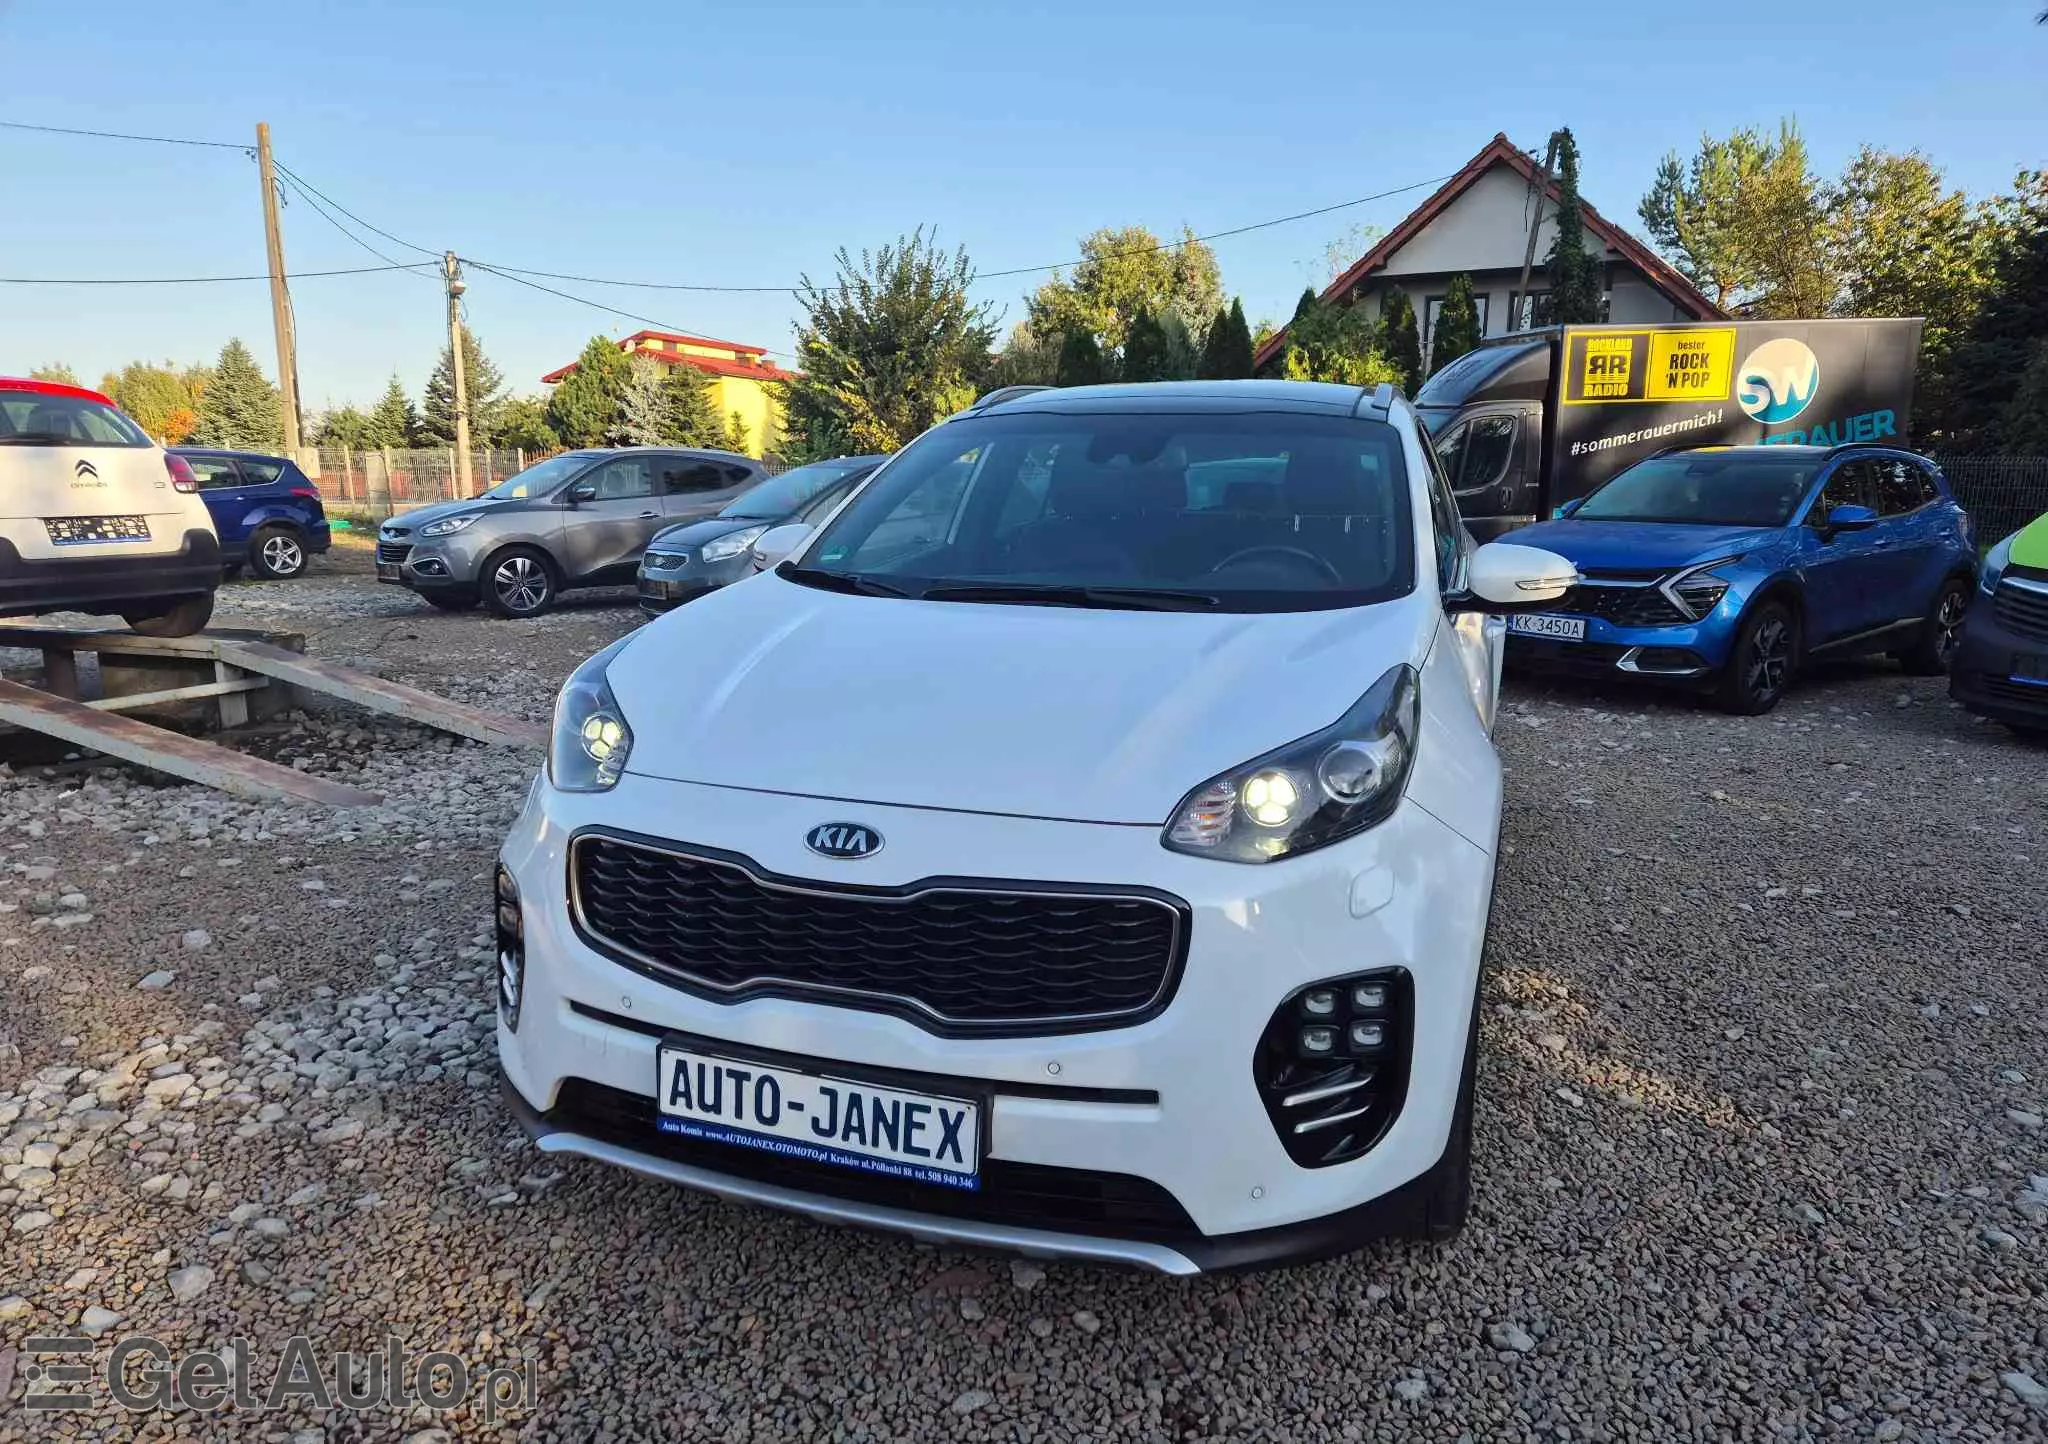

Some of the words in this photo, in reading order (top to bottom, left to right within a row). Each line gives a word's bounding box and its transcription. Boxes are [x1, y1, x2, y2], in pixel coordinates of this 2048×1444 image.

[1678, 340, 1706, 350] bester
[1669, 353, 1710, 370] ROCK
[1681, 372, 1710, 389] POP
[1584, 383, 1629, 397] RADIO
[1570, 408, 1724, 456] #sommerauermich!
[1537, 618, 1581, 637] 3450A
[813, 825, 868, 853] KIA
[669, 1059, 966, 1164] AUTO-JANEX
[662, 1120, 679, 1133] Auto
